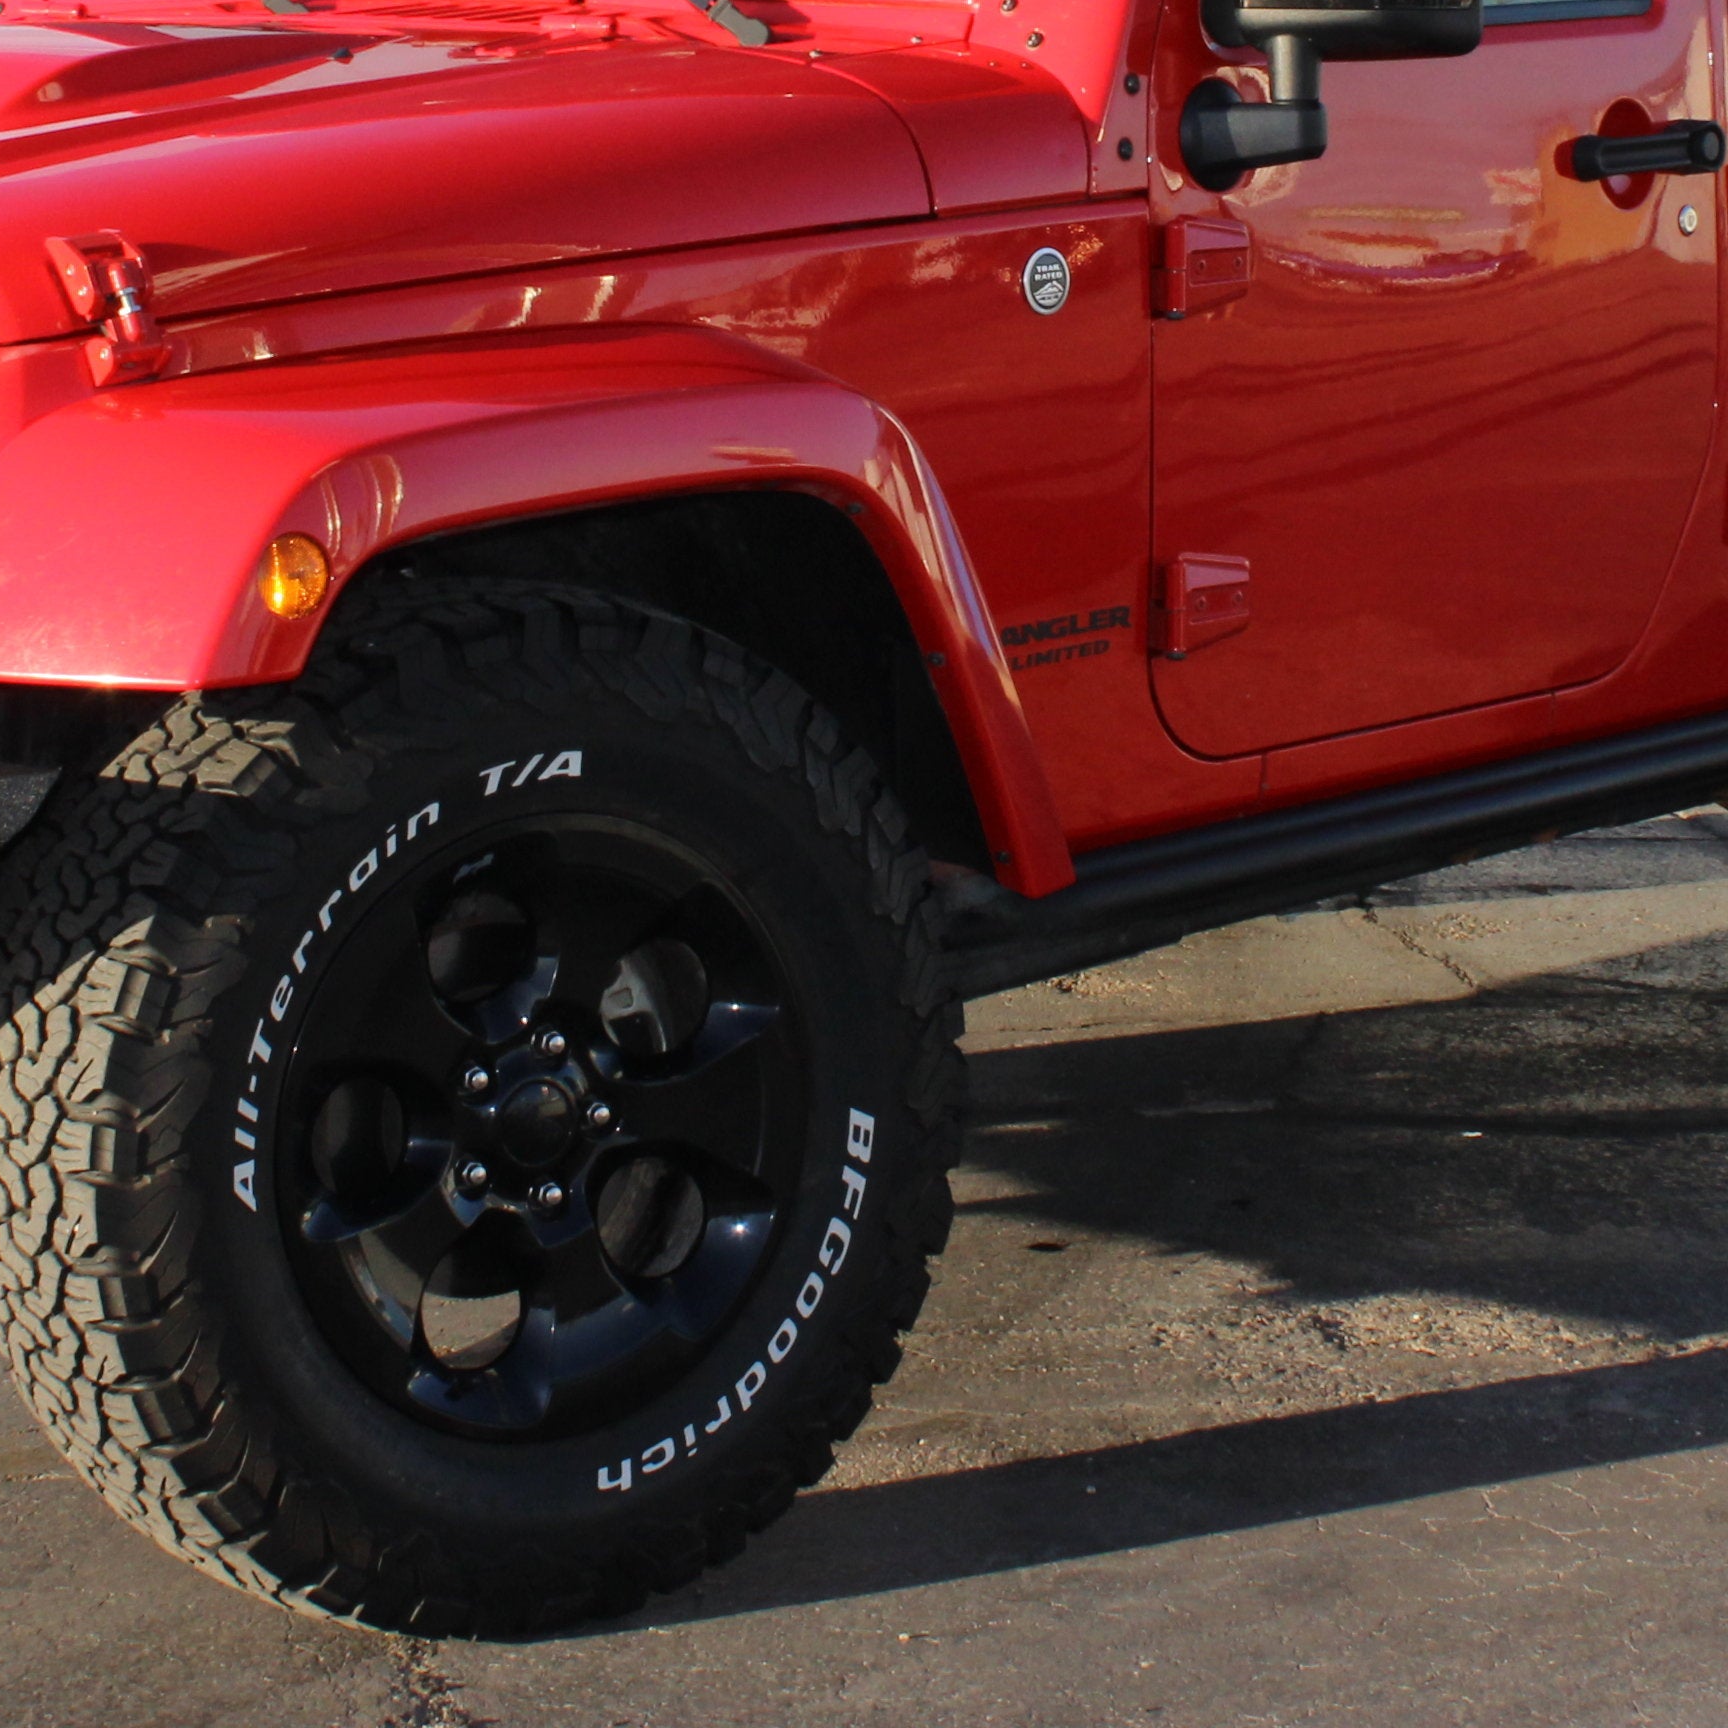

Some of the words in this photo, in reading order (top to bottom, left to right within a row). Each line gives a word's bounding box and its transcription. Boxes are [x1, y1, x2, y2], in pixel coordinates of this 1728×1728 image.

[1034, 272, 1063, 281] RATED
[1036, 263, 1060, 273] TRAIL
[1002, 605, 1133, 646] ANGLER
[1011, 639, 1111, 671] LIMITED
[231, 800, 442, 1213] All-Terrain
[479, 749, 584, 796] T/A
[597, 1106, 877, 1494] BFGoodrich
